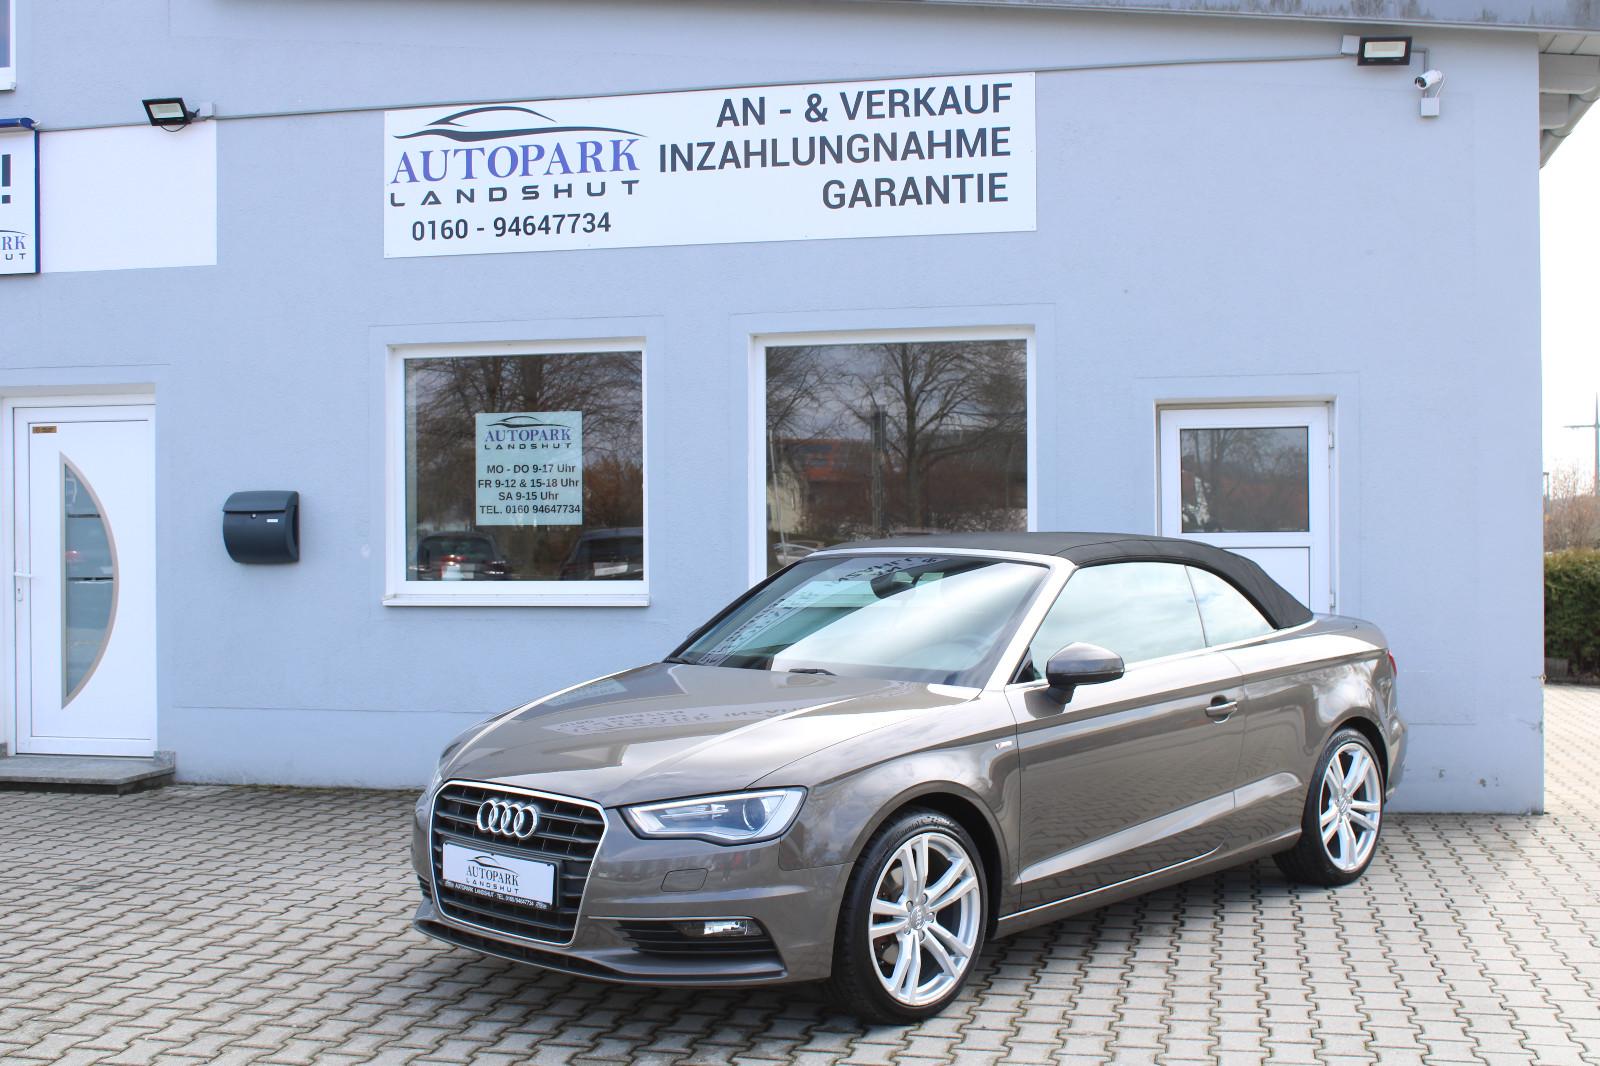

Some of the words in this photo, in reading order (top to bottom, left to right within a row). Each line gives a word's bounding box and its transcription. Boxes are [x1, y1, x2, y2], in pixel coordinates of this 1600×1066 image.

[716, 96, 766, 128] AN
[804, 93, 829, 123] &
[839, 82, 1013, 121] VERKAUF
[659, 126, 1011, 173] INZAHLUNGNAHME
[391, 138, 640, 184] AUTOPARK
[390, 179, 640, 208] LANDSHUT
[822, 172, 1009, 210] GARANTIE
[412, 218, 469, 242] 0160
[493, 211, 612, 238] 94647734
[485, 428, 572, 442] AUTOPARK
[487, 465, 504, 474] MO
[513, 464, 530, 474] DO
[532, 464, 554, 473] 9-17
[557, 463, 576, 473] Uhr
[478, 480, 492, 488] FR
[495, 479, 516, 488] 9-12
[519, 479, 527, 488] &
[530, 478, 558, 488] 15-18
[561, 478, 580, 487] Uhr
[498, 492, 513, 501] SA
[515, 491, 538, 500] 9-15
[540, 491, 559, 500] Uhr
[480, 505, 503, 514] TEL.
[506, 505, 530, 514] 0160
[532, 504, 581, 514] 94647734
[466, 865, 519, 886] AUTOPARK
[466, 878, 520, 894] LANDSHUT
